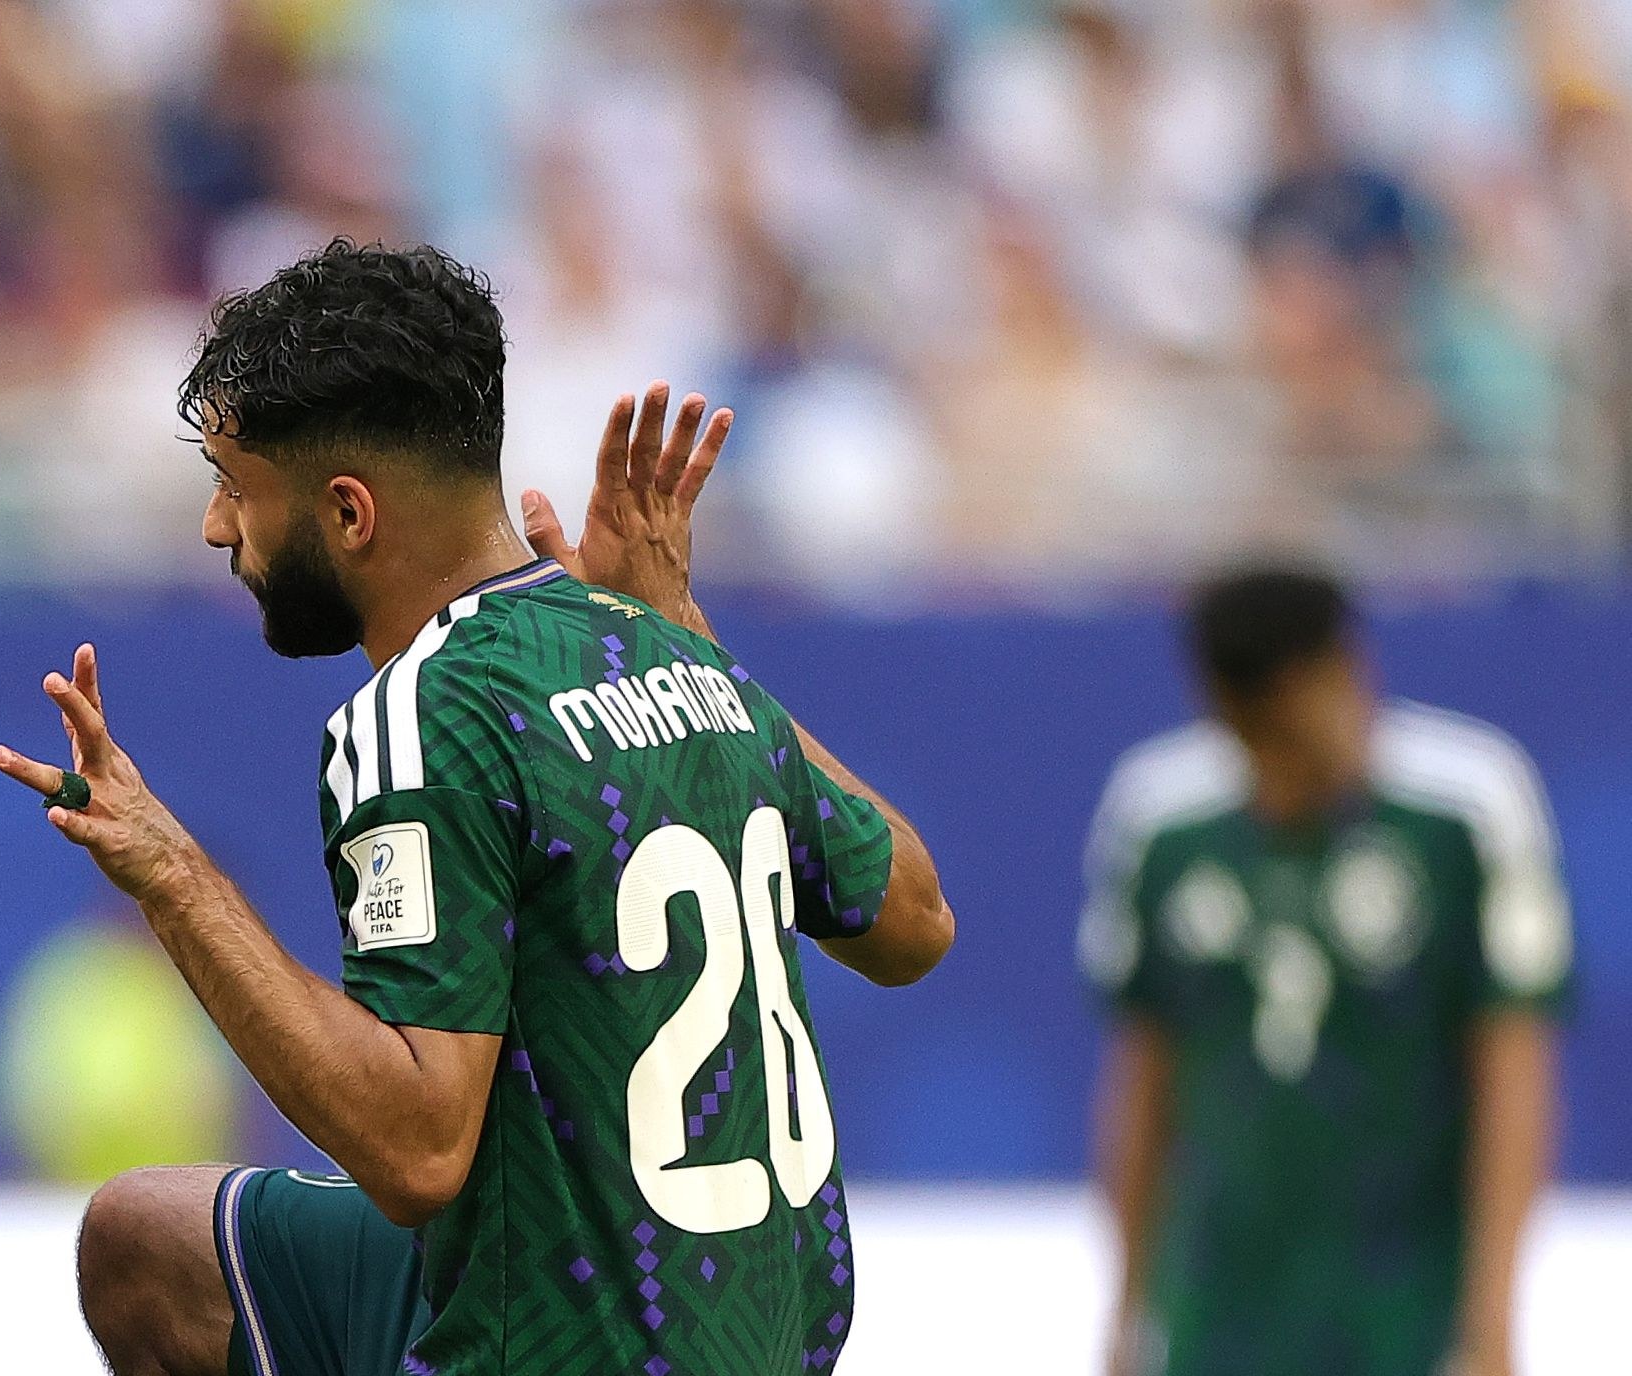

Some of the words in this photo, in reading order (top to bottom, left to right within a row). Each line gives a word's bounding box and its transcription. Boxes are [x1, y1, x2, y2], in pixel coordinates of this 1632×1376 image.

[363, 899, 404, 922] PEACE
[370, 922, 394, 934] FIFA
[616, 805, 836, 1234] 26
